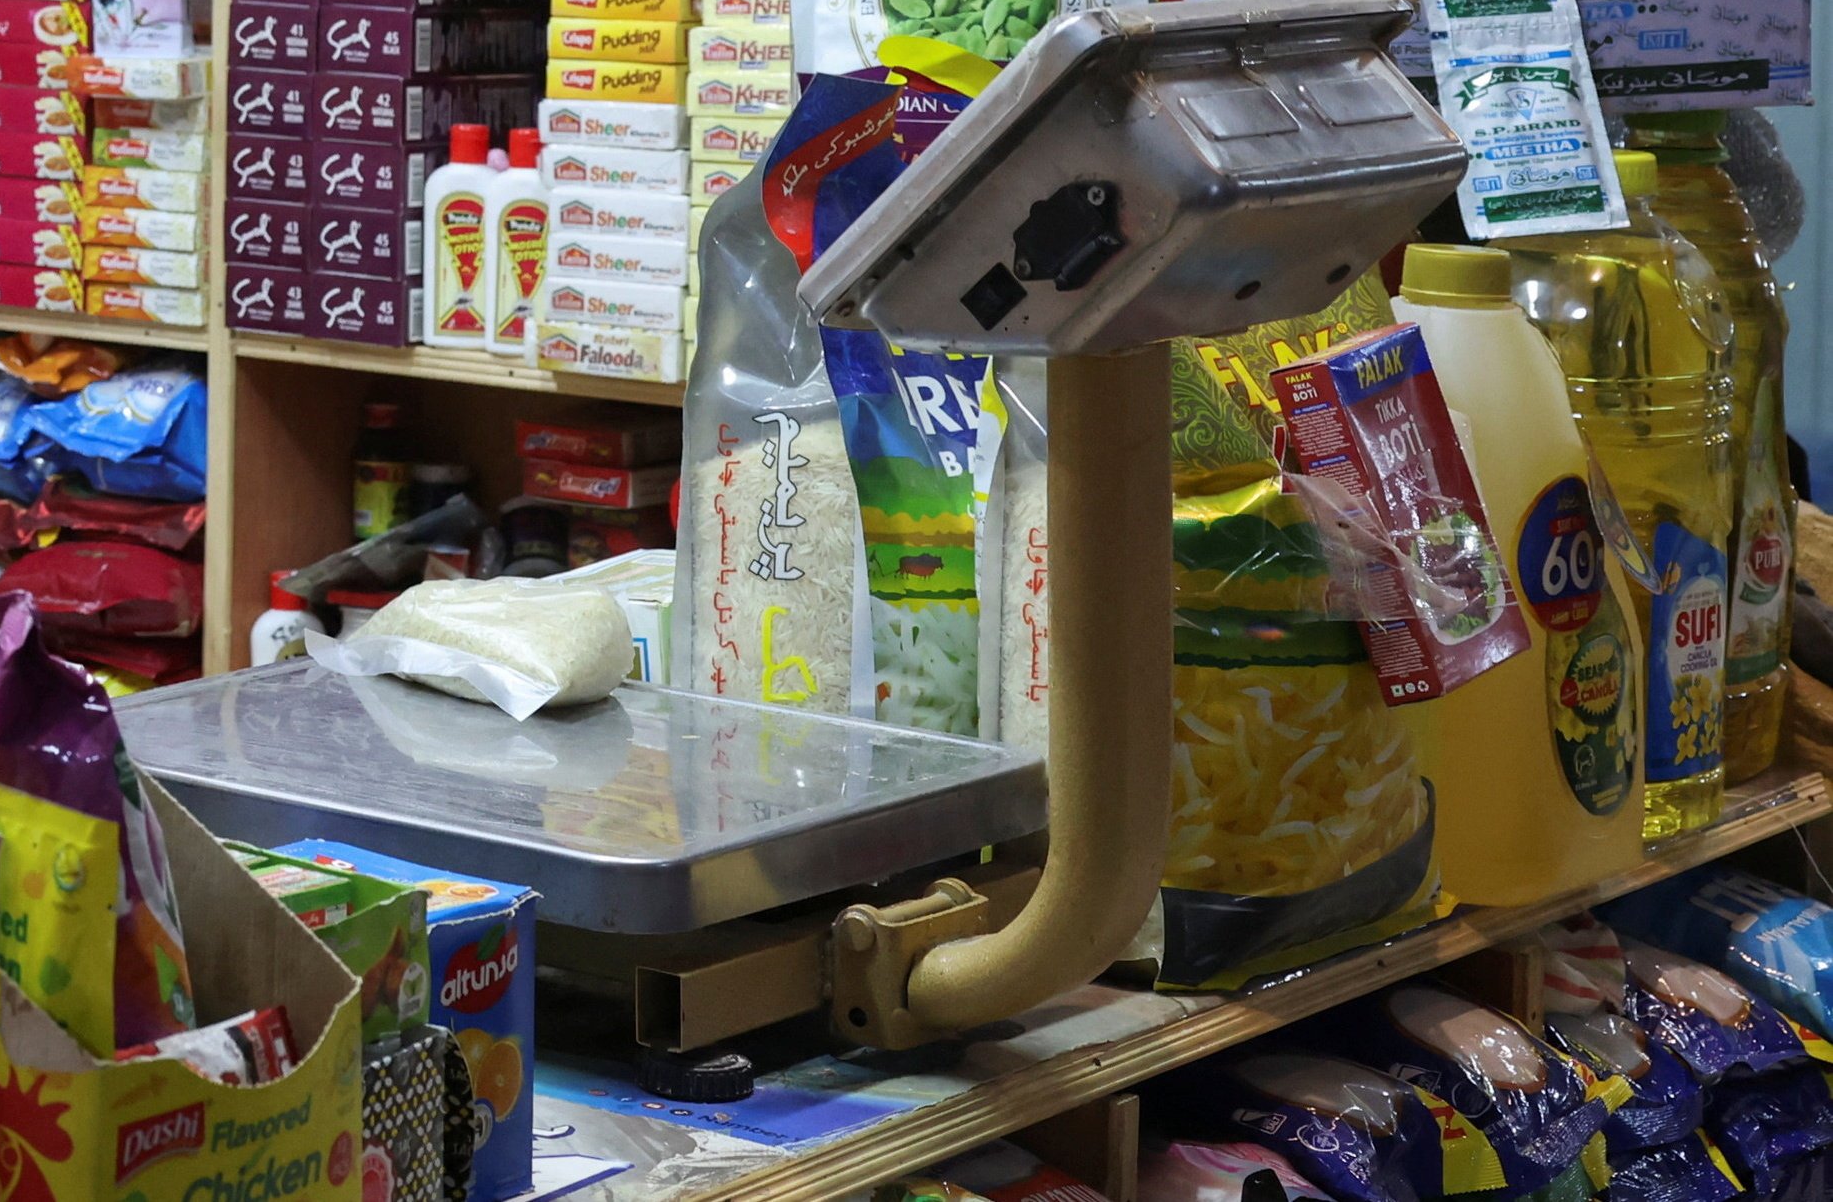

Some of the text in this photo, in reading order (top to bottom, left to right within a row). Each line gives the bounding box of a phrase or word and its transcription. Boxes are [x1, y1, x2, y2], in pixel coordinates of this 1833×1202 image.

[584, 118, 631, 136] Sheer
[1492, 140, 1574, 158] MEETHA
[589, 165, 637, 183] Sheer
[596, 211, 644, 229] Sheer
[593, 253, 640, 272] Sheer
[579, 345, 644, 368] Falooda
[1355, 345, 1404, 389] FALAK
[1285, 373, 1312, 386] FALAK
[1674, 603, 1721, 648] SUFI
[211, 1096, 310, 1151] Flavored
[122, 1108, 199, 1167] Dashi
